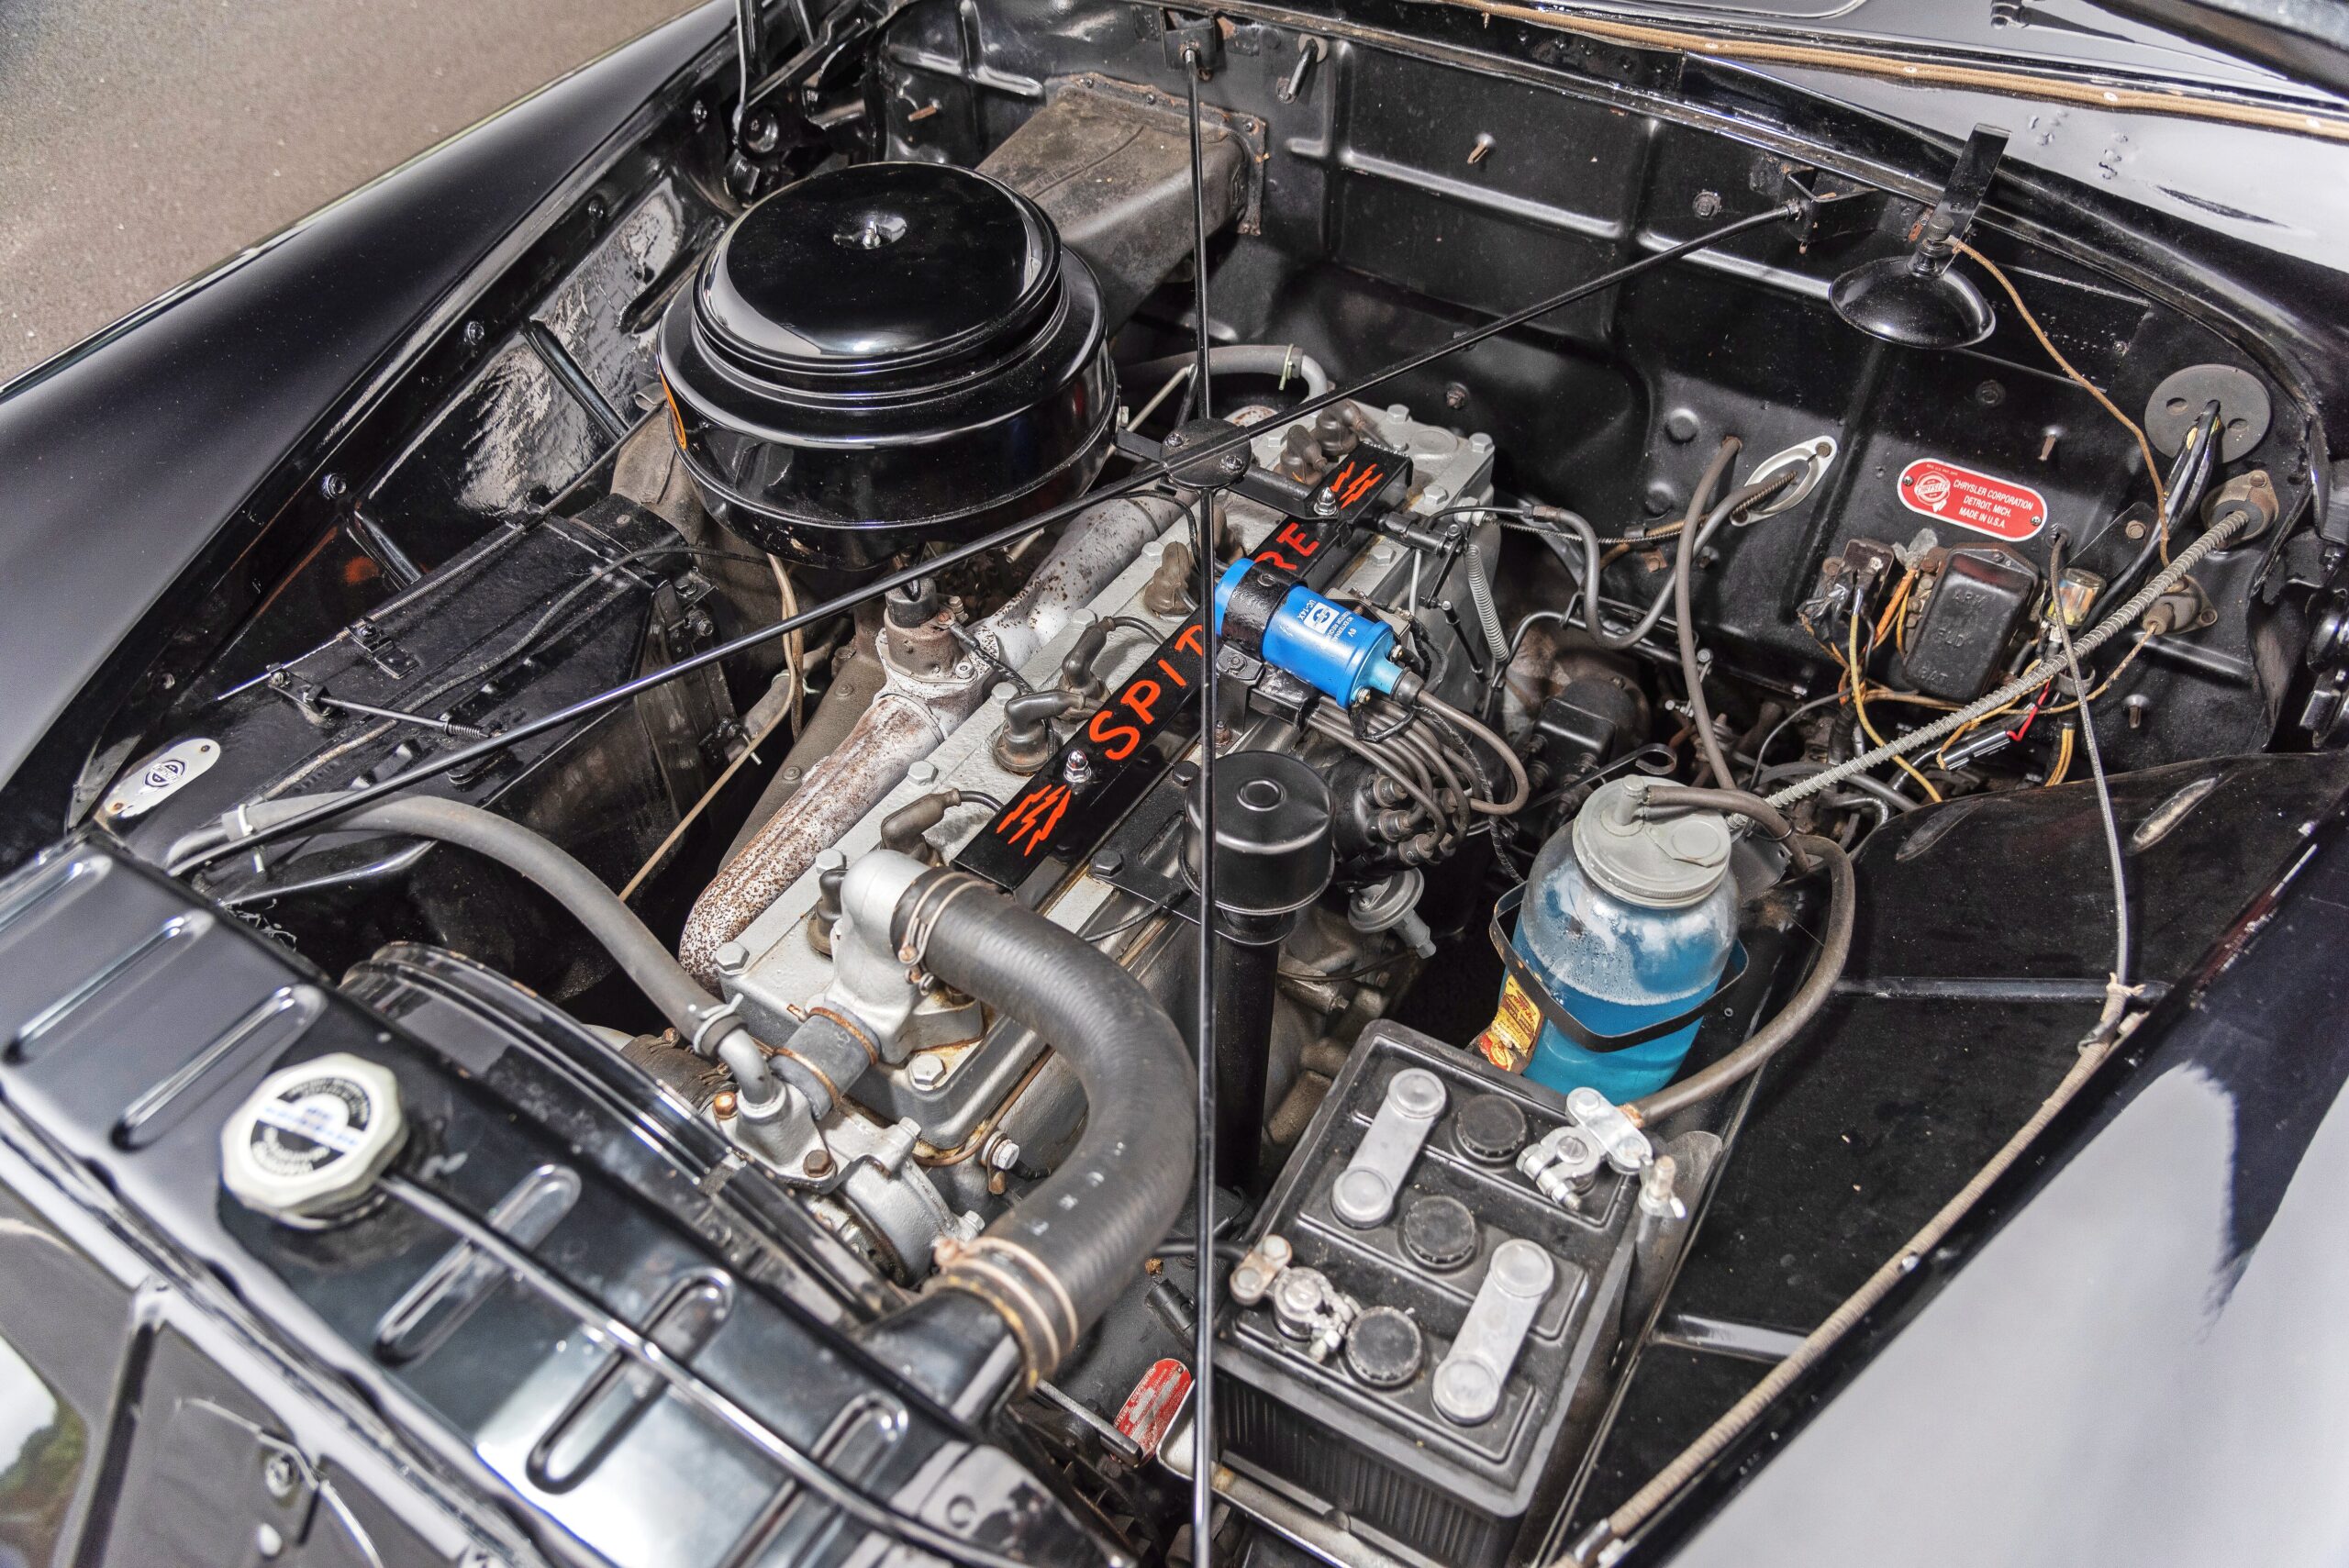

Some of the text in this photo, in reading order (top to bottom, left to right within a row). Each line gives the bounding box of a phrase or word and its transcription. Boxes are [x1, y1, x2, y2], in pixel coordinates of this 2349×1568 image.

[1953, 479, 2034, 511] CHRYSLER CORPORATION
[1963, 495, 2011, 517] DETROIT, MICH.
[1958, 506, 1977, 519] MADE
[1978, 513, 1987, 522] IN
[1297, 598, 1317, 621] UC-14X
[1088, 523, 1319, 761] SPITRE
[1331, 621, 1348, 642] EXTERNA
[1347, 628, 1357, 638] 6V
